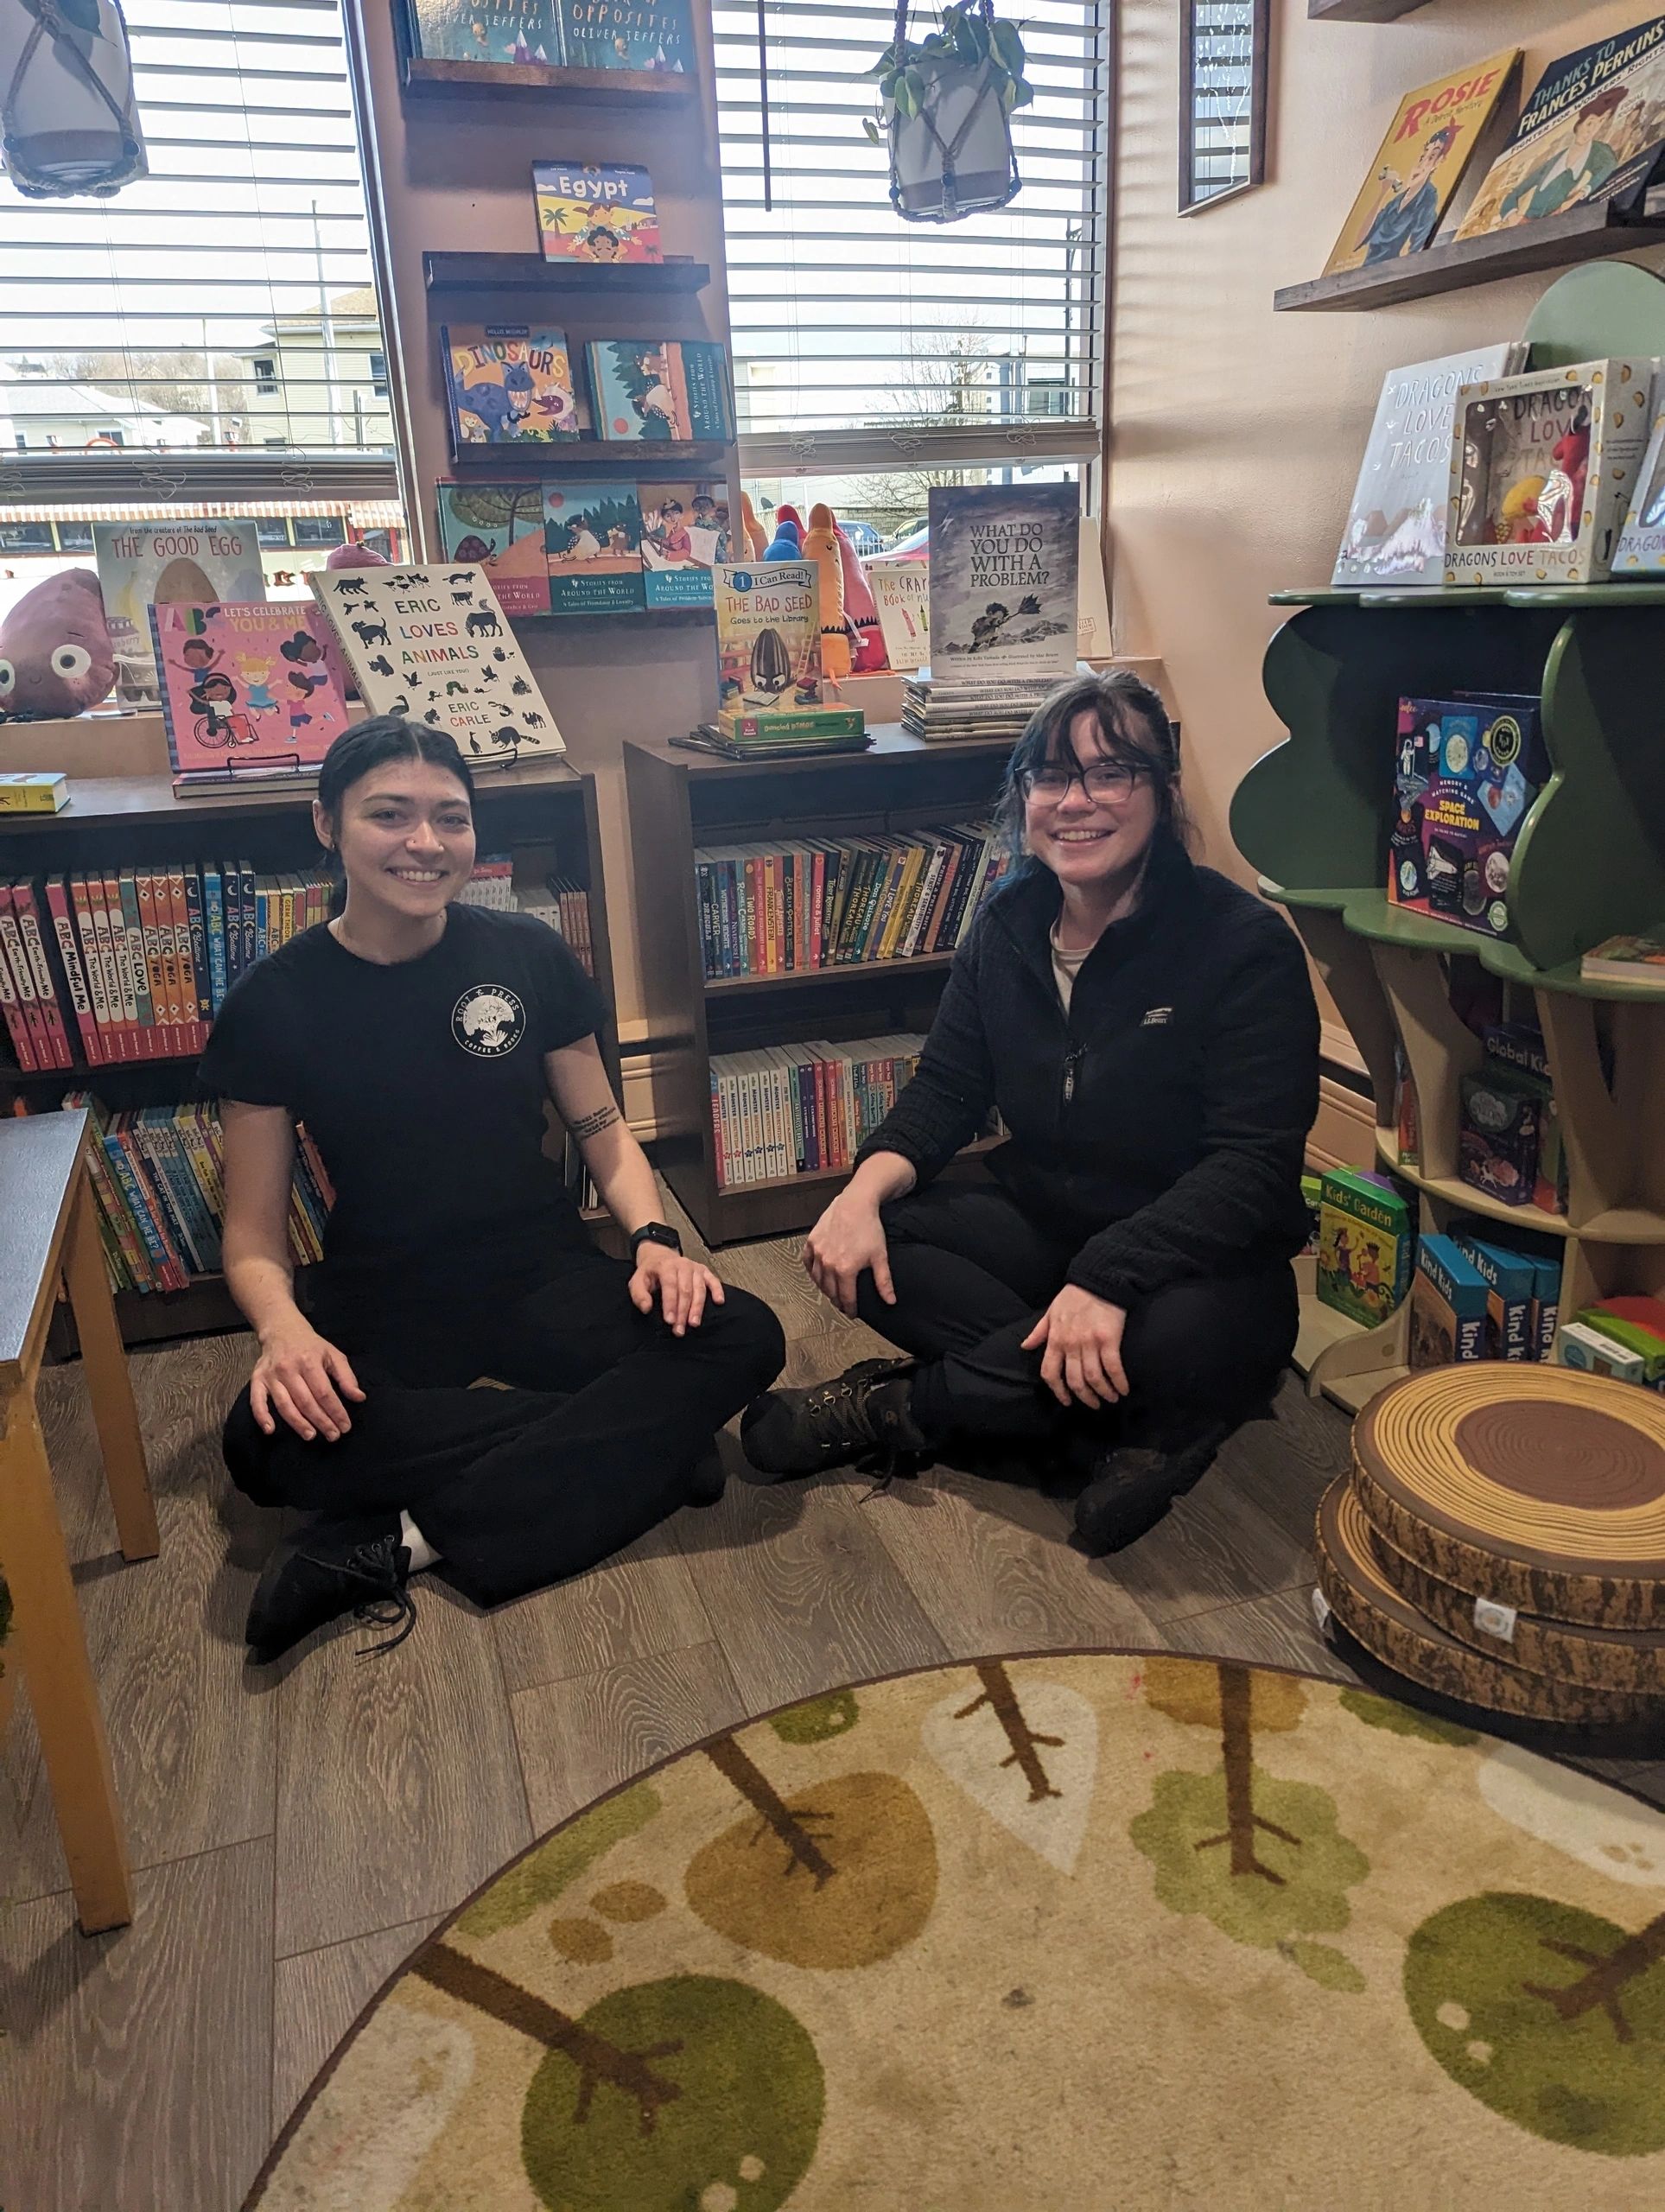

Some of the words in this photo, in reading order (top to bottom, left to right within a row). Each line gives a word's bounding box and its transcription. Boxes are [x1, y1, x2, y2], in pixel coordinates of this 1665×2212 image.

[573, 4, 677, 29] OPPOSITES
[573, 28, 617, 40] OLIVER
[626, 30, 680, 45] JEFFERS
[1517, 76, 1588, 137] FRANCES
[1591, 19, 1665, 86] PERKINS
[1535, 57, 1591, 109] THANKS
[1597, 41, 1616, 62] TO
[1393, 68, 1501, 144] ROSIE
[559, 176, 628, 200] Egypt
[454, 340, 566, 378] DINOSAURS
[1395, 365, 1483, 409] DRAGONS
[1403, 404, 1455, 435] LOVE
[1390, 433, 1452, 468] TACOS
[970, 524, 1016, 537] WHAT
[1020, 523, 1043, 537] DO
[111, 537, 143, 558] THE
[154, 536, 199, 557] GOOD
[209, 536, 242, 556] EGG
[970, 538, 1008, 555] YOU
[1015, 537, 1043, 553] DO
[970, 555, 1024, 572] WITH
[1029, 554, 1042, 570] A
[1445, 552, 1497, 568] DRAGONS
[1501, 550, 1534, 566] LOVE
[1540, 550, 1586, 566] TACOS
[740, 576, 746, 588] 1
[759, 575, 778, 585] Can
[778, 571, 804, 581] Read!
[970, 571, 1050, 588] PROBLEM?
[224, 607, 251, 618] LET'S
[253, 606, 306, 616] CELEBRATE
[394, 599, 442, 614] ERIC
[726, 596, 749, 613] THE
[755, 595, 779, 613] BAD
[785, 594, 812, 613] SEED
[229, 618, 265, 632] YOU
[268, 617, 282, 632] &
[283, 616, 307, 630] ME
[399, 621, 459, 639] LOVES
[782, 615, 809, 625] Library
[402, 645, 480, 664] ANIMALS
[448, 702, 480, 714] ERIC
[449, 714, 491, 728] CARLE
[1425, 809, 1479, 830] EXPLORATION
[1439, 799, 1465, 816] SPACE
[926, 874, 937, 892] SENSE
[937, 864, 945, 887] PRIDE
[873, 882, 882, 898] Don
[885, 893, 895, 908] LOVE
[906, 881, 925, 920] THOREAU
[747, 896, 755, 912] TWO
[846, 886, 861, 925] THOREAU
[855, 884, 870, 925] THOREAU
[862, 899, 876, 931] Quixote
[914, 897, 930, 931] SENSIBILITY
[922, 894, 937, 931] PREJUDICE
[188, 908, 202, 931] ABC
[210, 915, 222, 935] ABC
[227, 906, 239, 930] ABC
[702, 902, 712, 940] DRACULA
[711, 903, 721, 936] CARVER
[747, 913, 756, 940] ROADS
[880, 912, 891, 922] YOU
[57, 921, 74, 950] ABC
[82, 927, 97, 954] ABC
[130, 934, 143, 961] ABC
[144, 927, 159, 957] ABC
[160, 926, 174, 955] ABC
[193, 931, 202, 963] Bedtime
[213, 938, 223, 957] WHAT
[230, 930, 238, 962] Bedtime
[2, 920, 20, 948] ABC
[12, 948, 25, 987] Earth-Friendly
[22, 986, 31, 998] Me
[22, 918, 41, 946] ABC
[41, 984, 49, 996] Me
[98, 926, 111, 953] ABC
[106, 968, 116, 988] World
[111, 995, 118, 1008] Me
[65, 951, 83, 992] Mindful
[92, 969, 101, 989] World
[134, 963, 147, 992] Love
[150, 959, 162, 986] YOGA
[165, 958, 176, 985] YOGA
[216, 976, 224, 987] HE
[3, 988, 11, 1000] Me
[74, 995, 86, 1010] Me
[96, 996, 104, 1009] Me
[455, 995, 471, 1022] ROOT
[492, 988, 519, 1012] PRESS
[464, 1039, 492, 1053] COFFEE
[711, 1099, 721, 1134] LEADERS
[120, 1172, 135, 1192] ABC
[129, 1189, 141, 1209] WHAT
[137, 1210, 147, 1225] CAN
[142, 1225, 152, 1236] HE
[148, 1236, 159, 1249] BE?
[1325, 1184, 1350, 1206] Kids'
[1354, 1198, 1392, 1227] Garden
[1421, 1249, 1438, 1280] Kind
[1438, 1268, 1452, 1300] Kids
[1460, 1321, 1480, 1360] Kind
